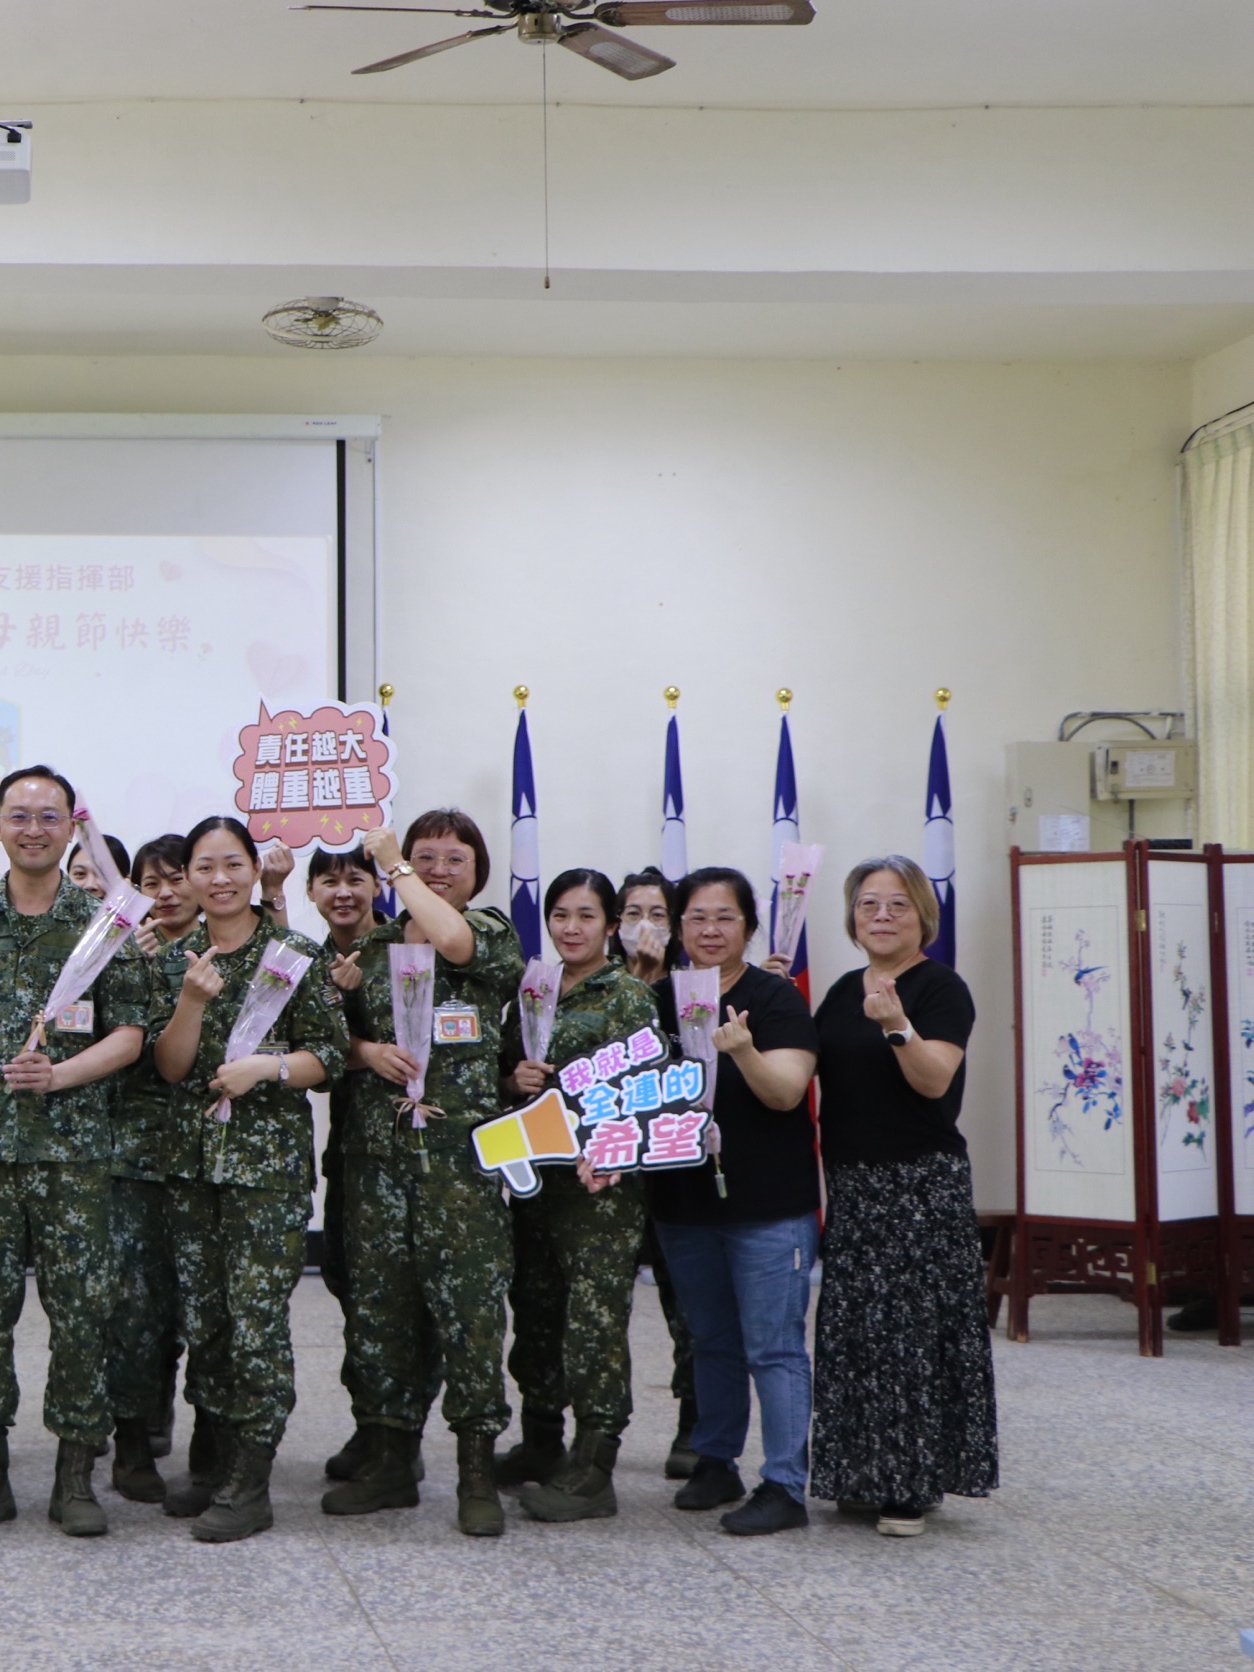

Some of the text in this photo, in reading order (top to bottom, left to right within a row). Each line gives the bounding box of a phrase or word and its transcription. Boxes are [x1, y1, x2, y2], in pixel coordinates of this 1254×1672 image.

[13, 662, 51, 679] Day
[255, 730, 367, 767] 責任越大
[249, 766, 376, 811] 體重越重
[559, 1029, 664, 1094] 我就是
[581, 1061, 703, 1125] 全連的
[584, 1112, 708, 1167] 希望
